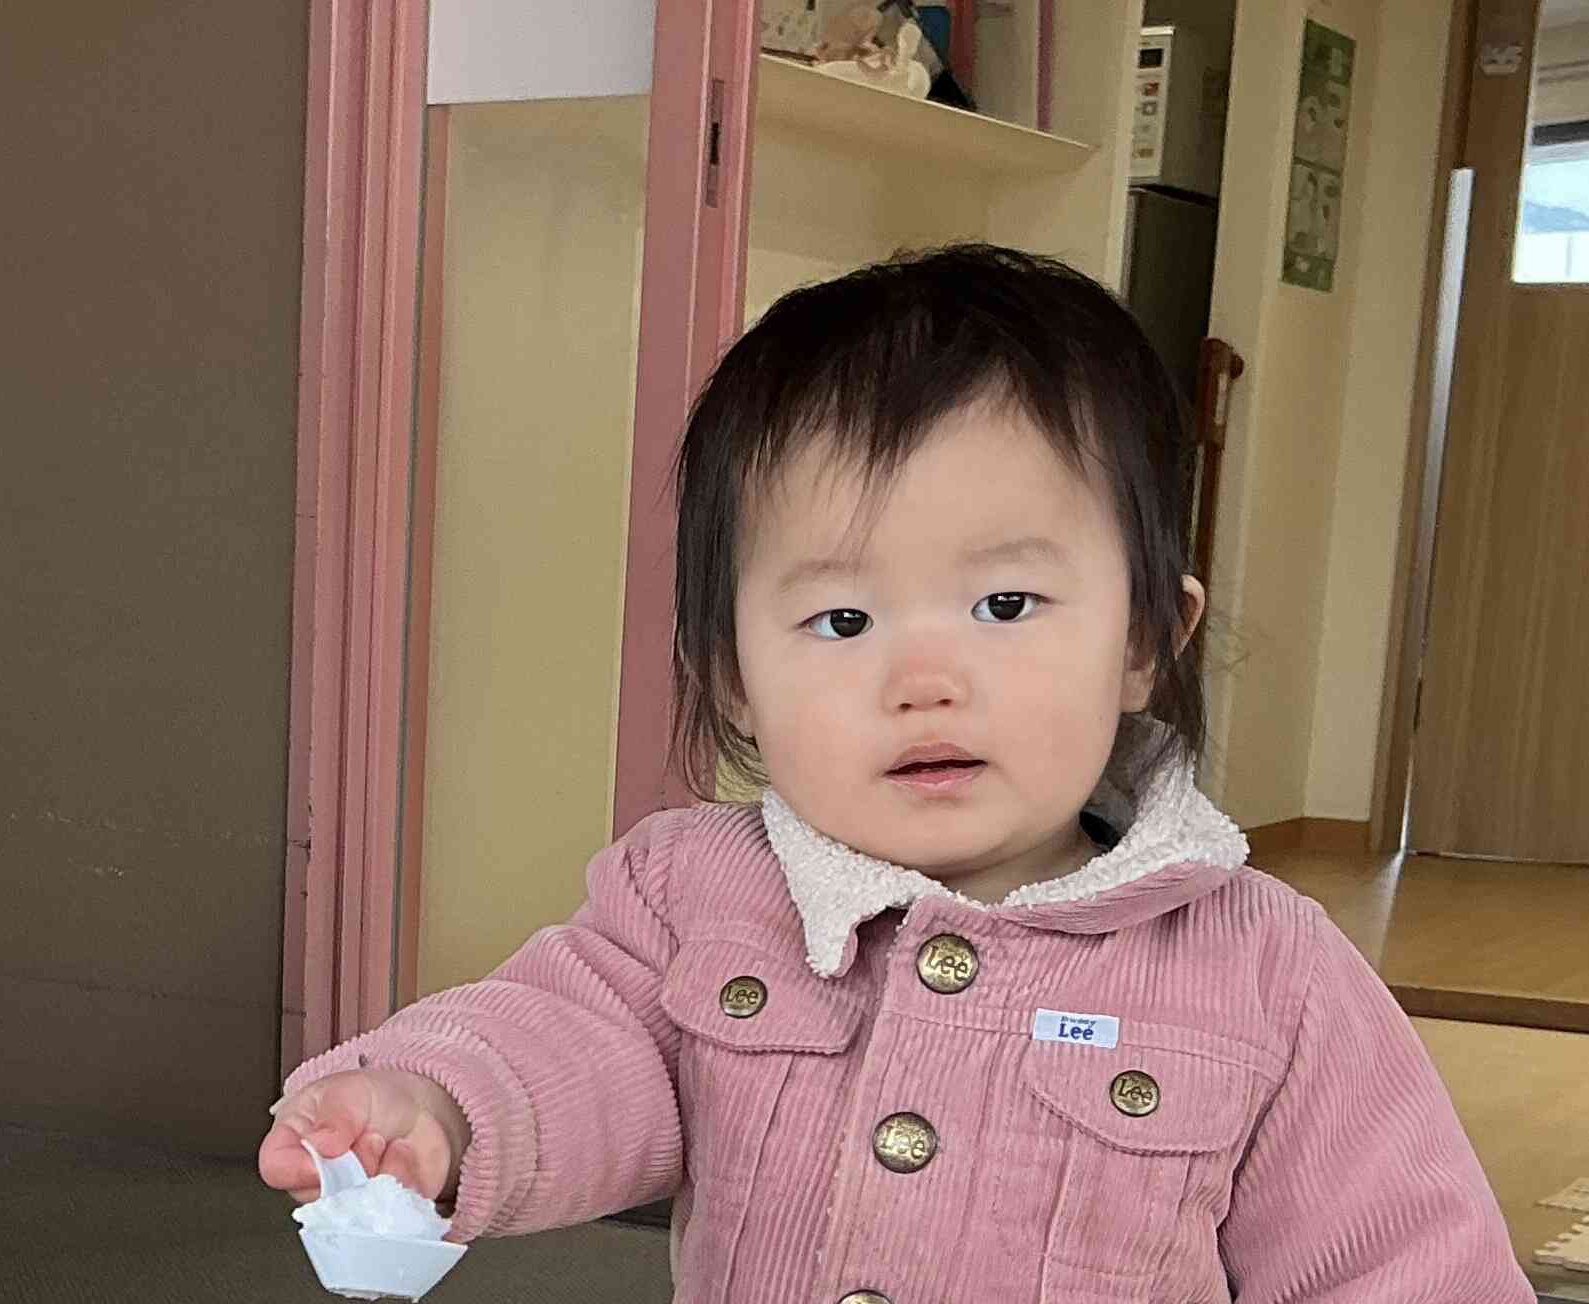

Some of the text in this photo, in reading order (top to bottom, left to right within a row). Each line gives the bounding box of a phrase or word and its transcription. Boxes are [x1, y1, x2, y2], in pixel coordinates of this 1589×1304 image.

[925, 945, 969, 982] Lee
[1058, 1023, 1094, 1041] Lee
[1118, 1079, 1153, 1107] Lee
